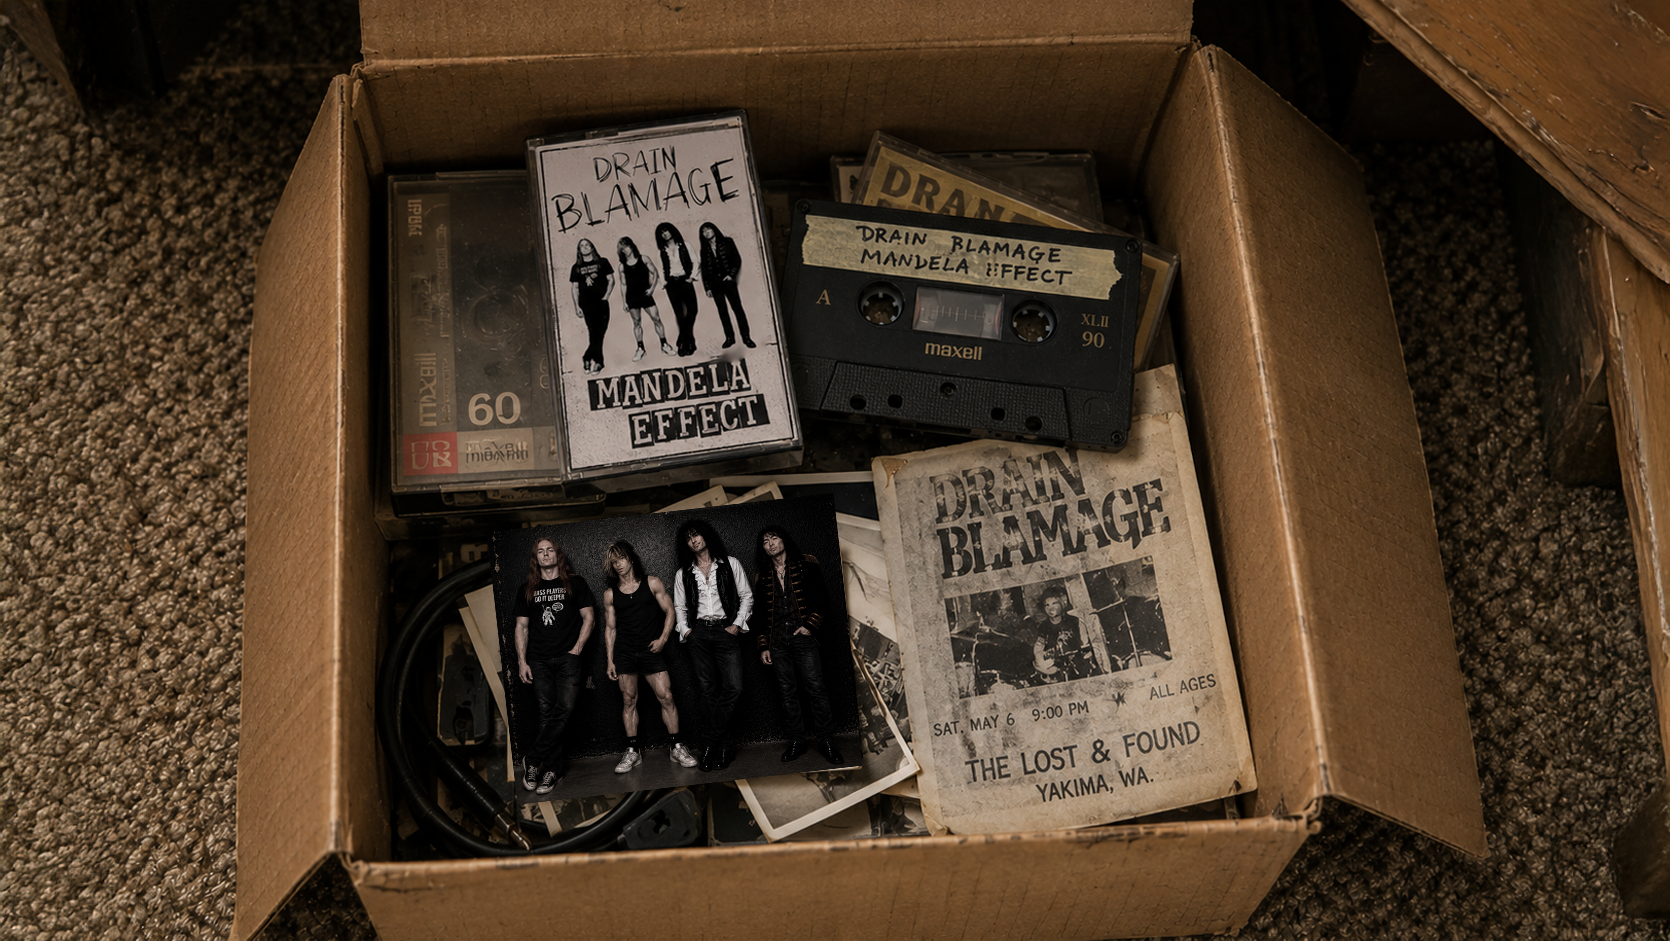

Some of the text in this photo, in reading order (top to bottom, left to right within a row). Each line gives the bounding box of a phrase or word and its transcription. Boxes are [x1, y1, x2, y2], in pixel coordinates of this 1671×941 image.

[593, 145, 677, 184] DRAIN
[551, 158, 740, 234] BLAMAGE
[855, 225, 1062, 264] DRAIN BLAMAGE
[860, 248, 970, 276] MANDELA
[816, 288, 832, 306] A
[925, 341, 983, 361] maxell
[1082, 331, 1105, 349] 90
[595, 359, 752, 409] MANDELA
[467, 392, 522, 426] 60
[631, 396, 758, 445] EFFECT
[930, 448, 1088, 524] DRAIN
[937, 478, 1171, 579] BLAMAGE
[933, 674, 1216, 737] SAT. MAY 6 9:00 PM ALL AGES
[965, 720, 1201, 783] THE LOST & FOUND
[1036, 768, 1154, 803] YAKIMA, WA.
